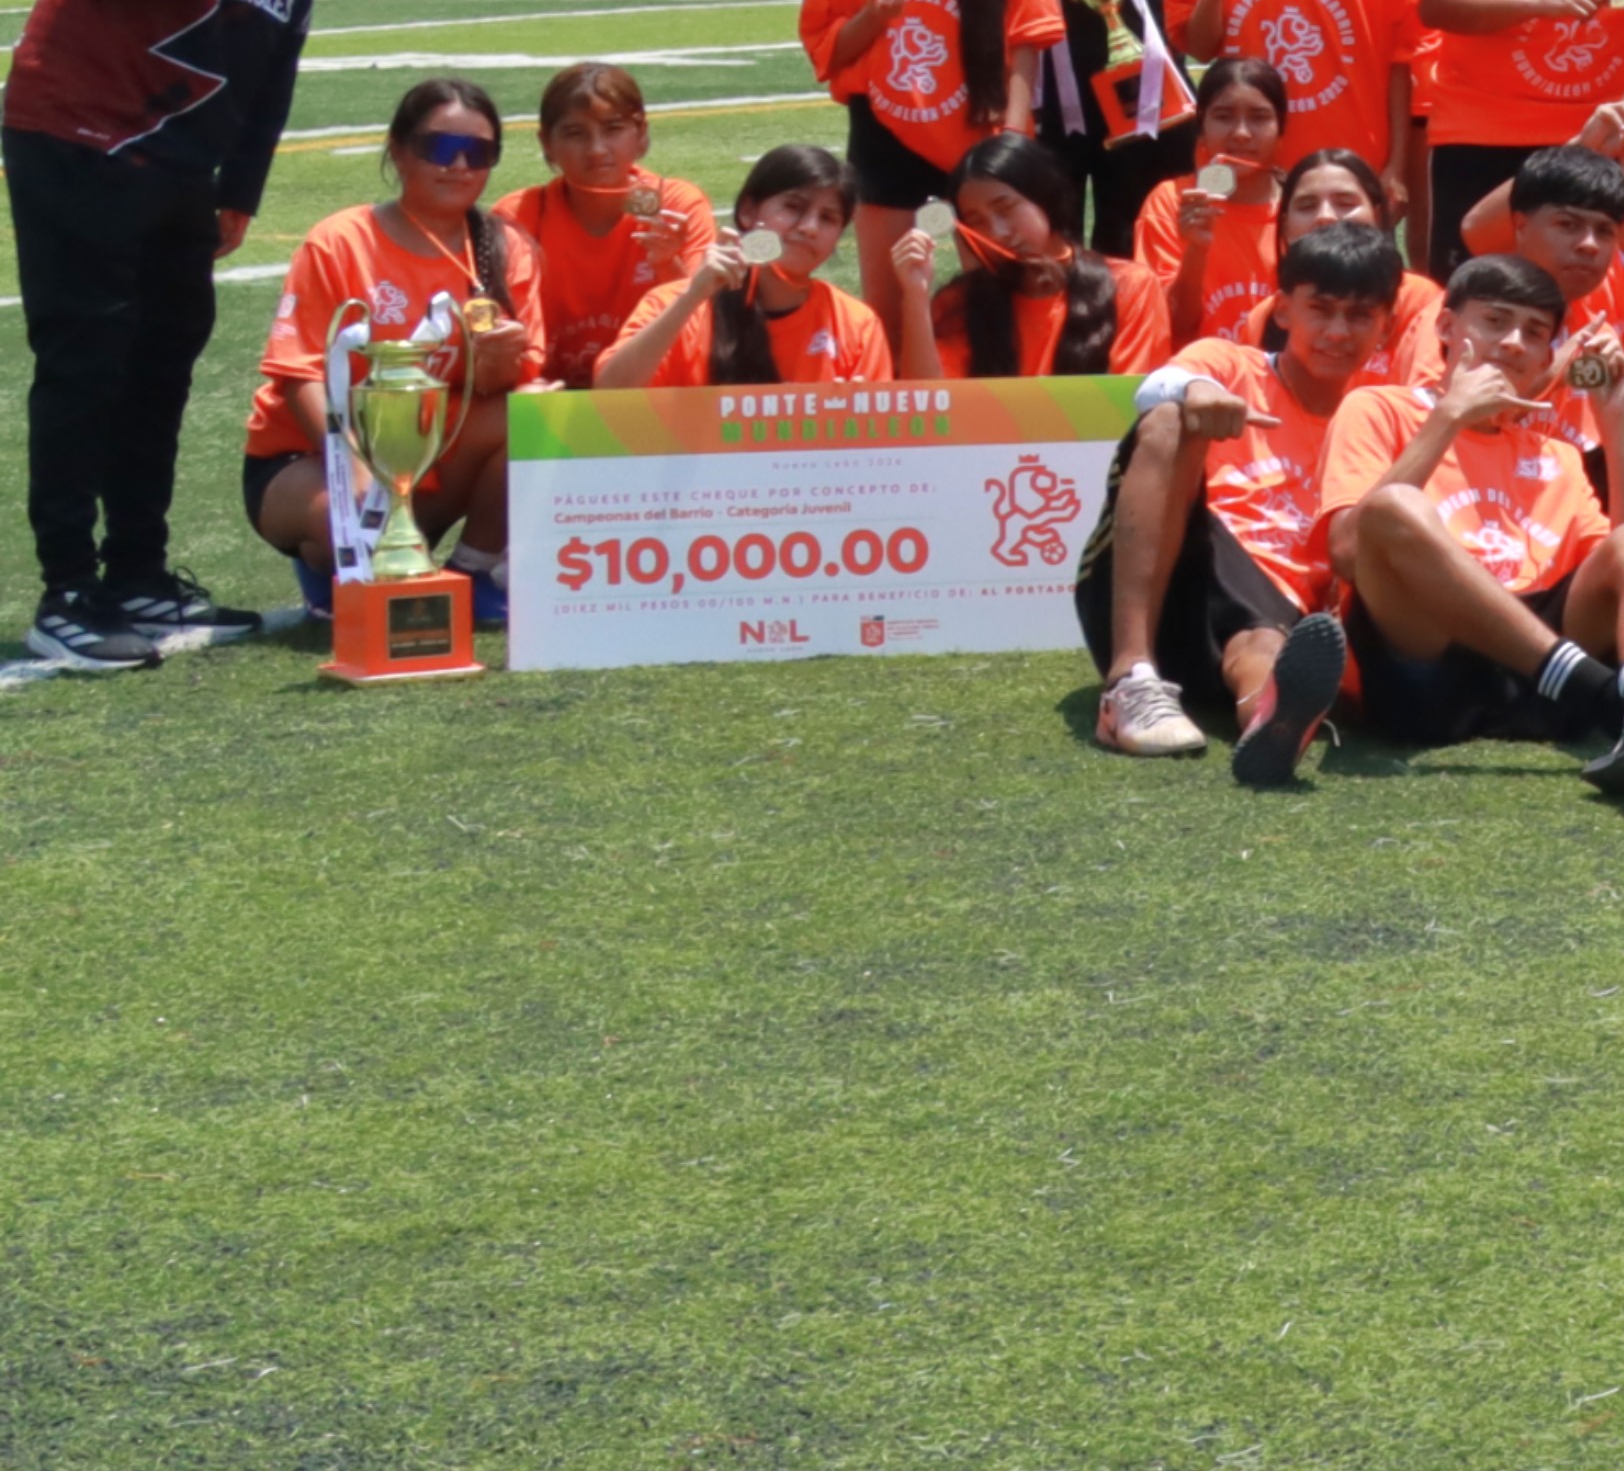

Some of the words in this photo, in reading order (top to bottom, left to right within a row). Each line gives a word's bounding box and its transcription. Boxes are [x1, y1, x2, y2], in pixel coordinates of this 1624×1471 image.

[720, 393, 817, 418] PONTE
[853, 389, 950, 413] NUEVO
[768, 487, 800, 498] POR
[643, 508, 665, 520] del
[669, 506, 713, 519] Barrio
[801, 501, 851, 514] Juvenil
[555, 523, 929, 599] $10,000.00
